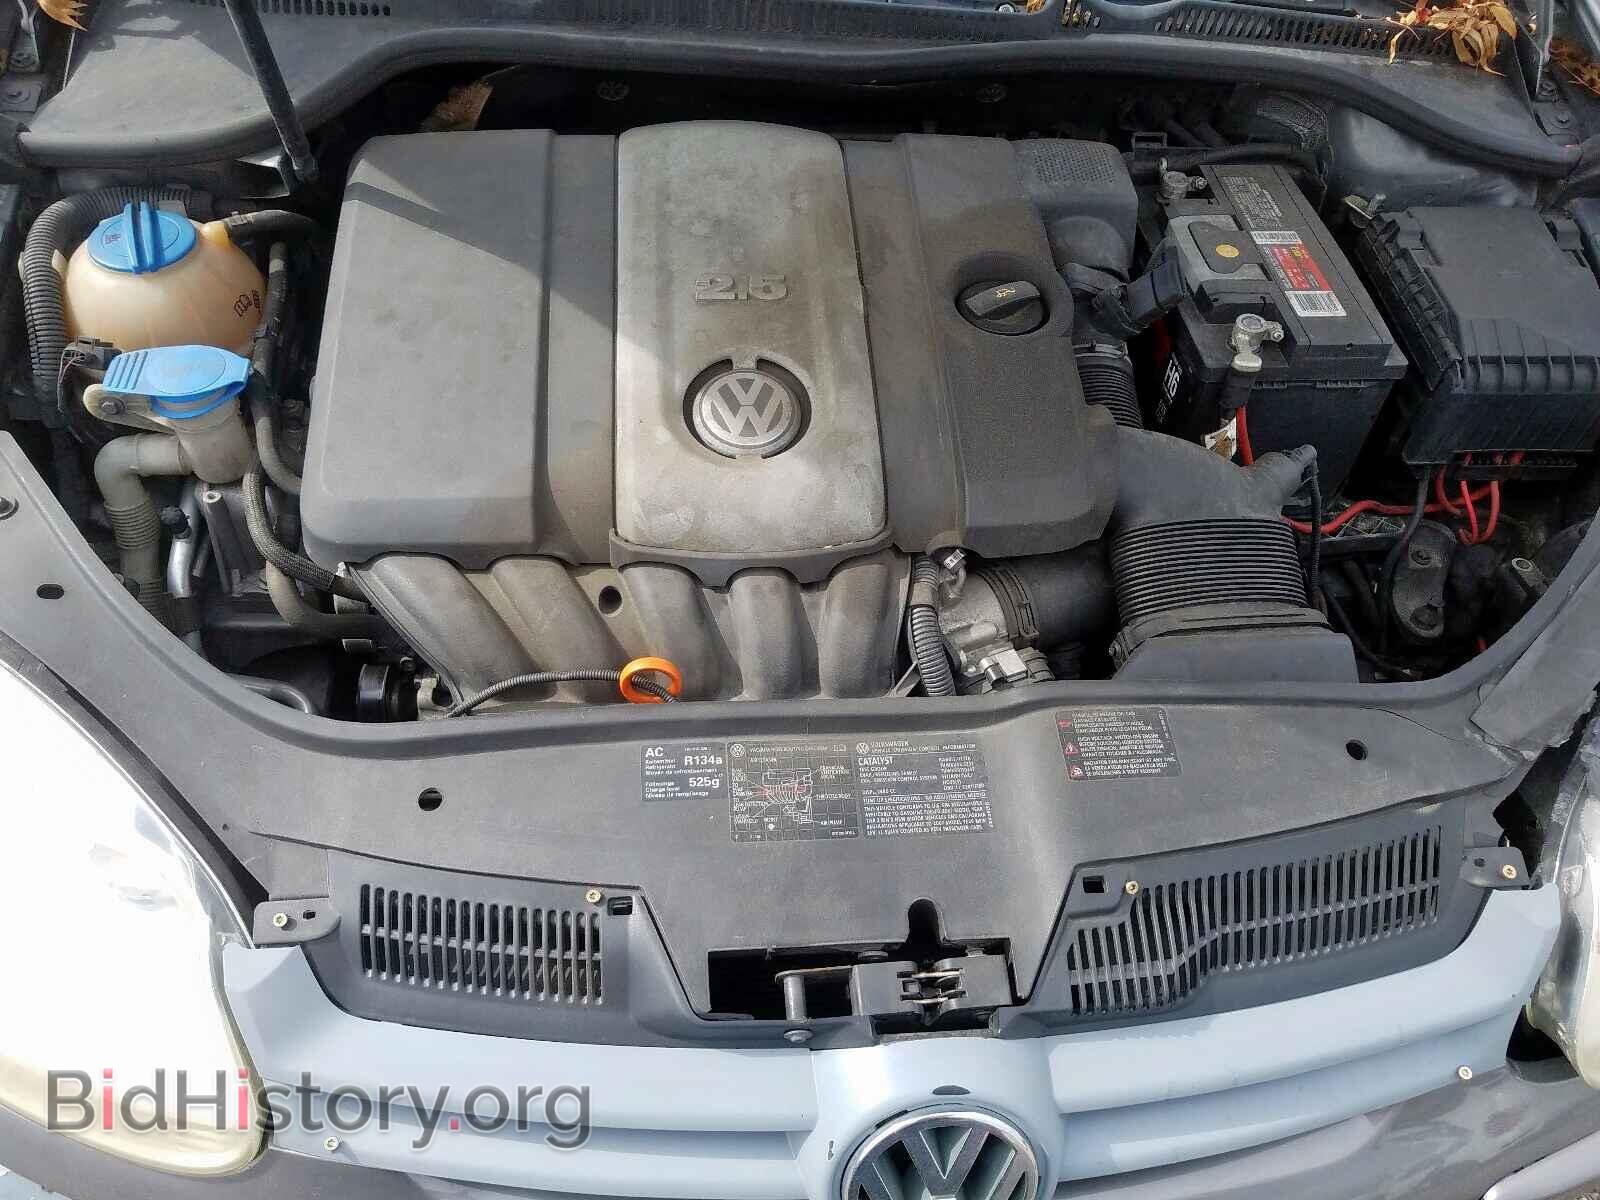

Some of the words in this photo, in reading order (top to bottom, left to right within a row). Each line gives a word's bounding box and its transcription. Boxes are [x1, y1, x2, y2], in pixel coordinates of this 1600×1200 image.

[695, 273, 788, 302] 2.5
[646, 747, 664, 757] AC
[685, 755, 722, 765] R134a
[859, 756, 893, 766] CATALYST
[689, 777, 720, 788] 525g
